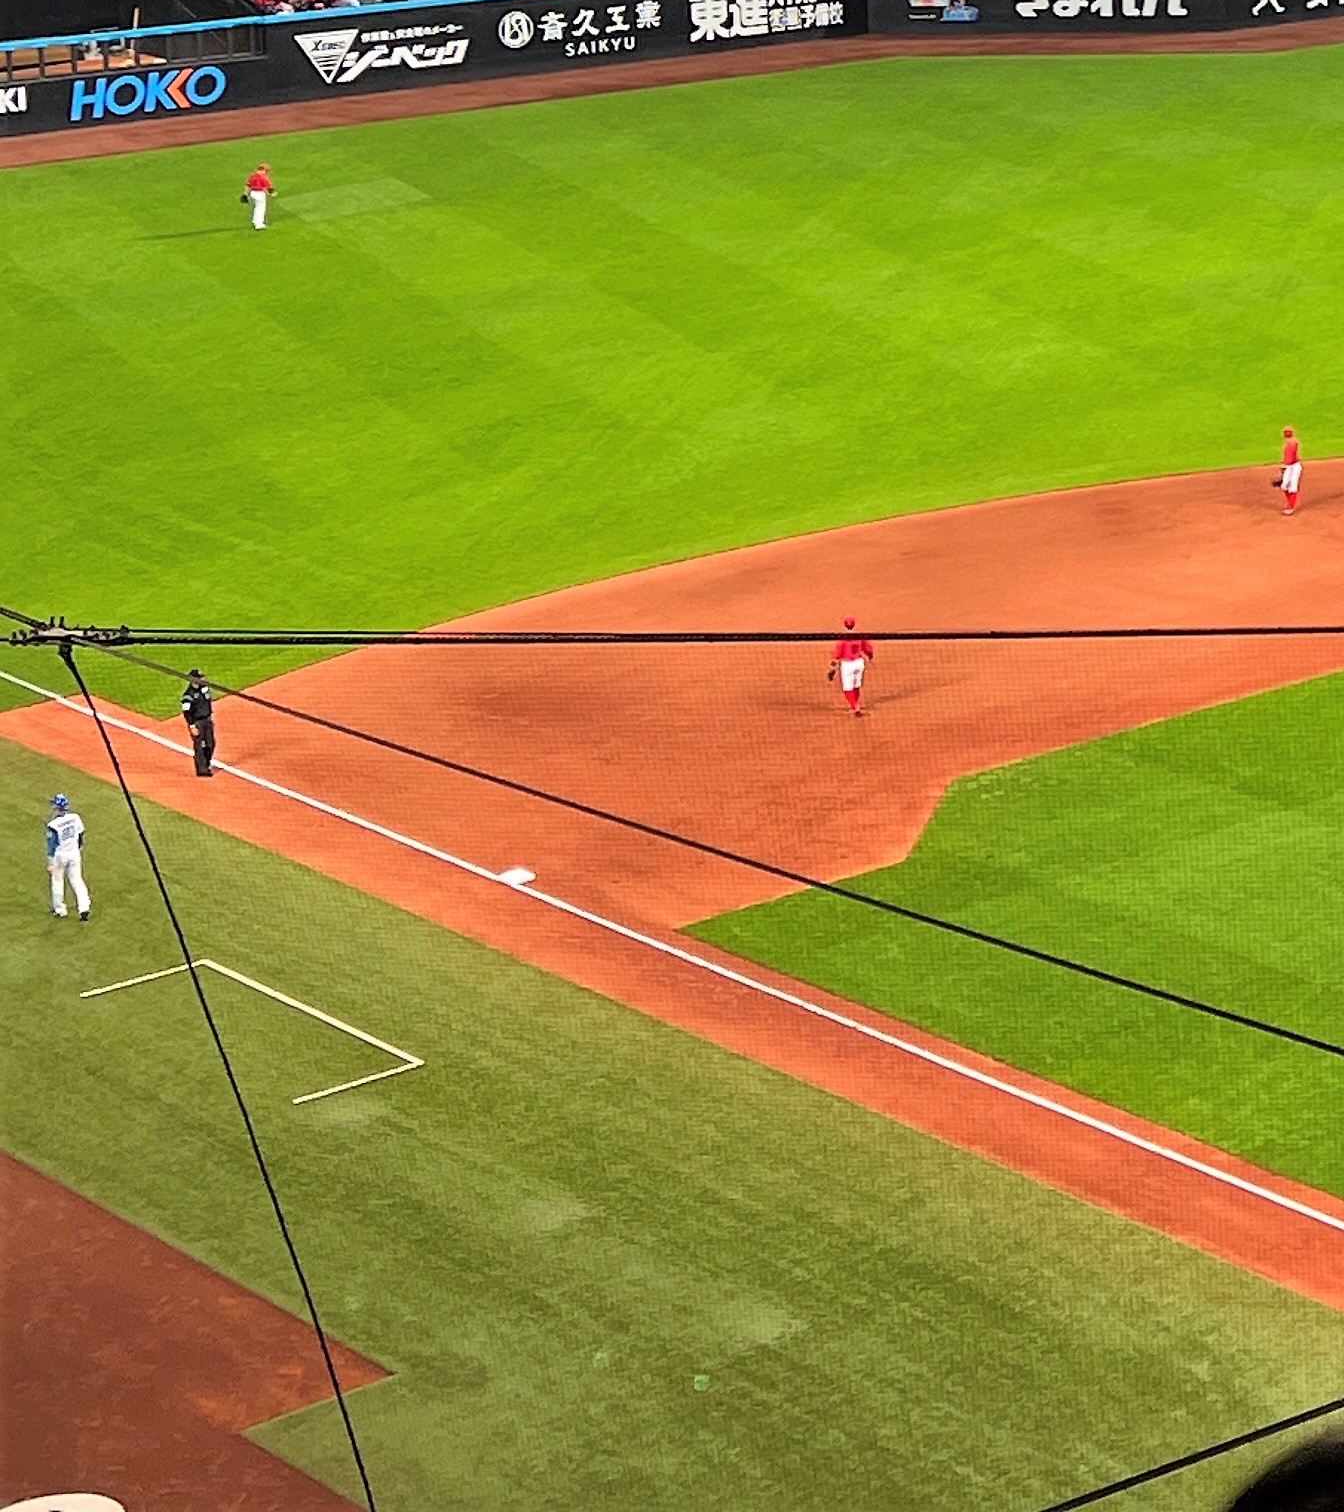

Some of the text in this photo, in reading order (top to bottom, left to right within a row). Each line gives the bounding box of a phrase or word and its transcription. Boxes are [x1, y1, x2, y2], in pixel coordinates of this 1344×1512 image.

[337, 37, 470, 83] ジーベック
[565, 36, 636, 57] SAIKYU
[70, 65, 227, 122] HOKKO
